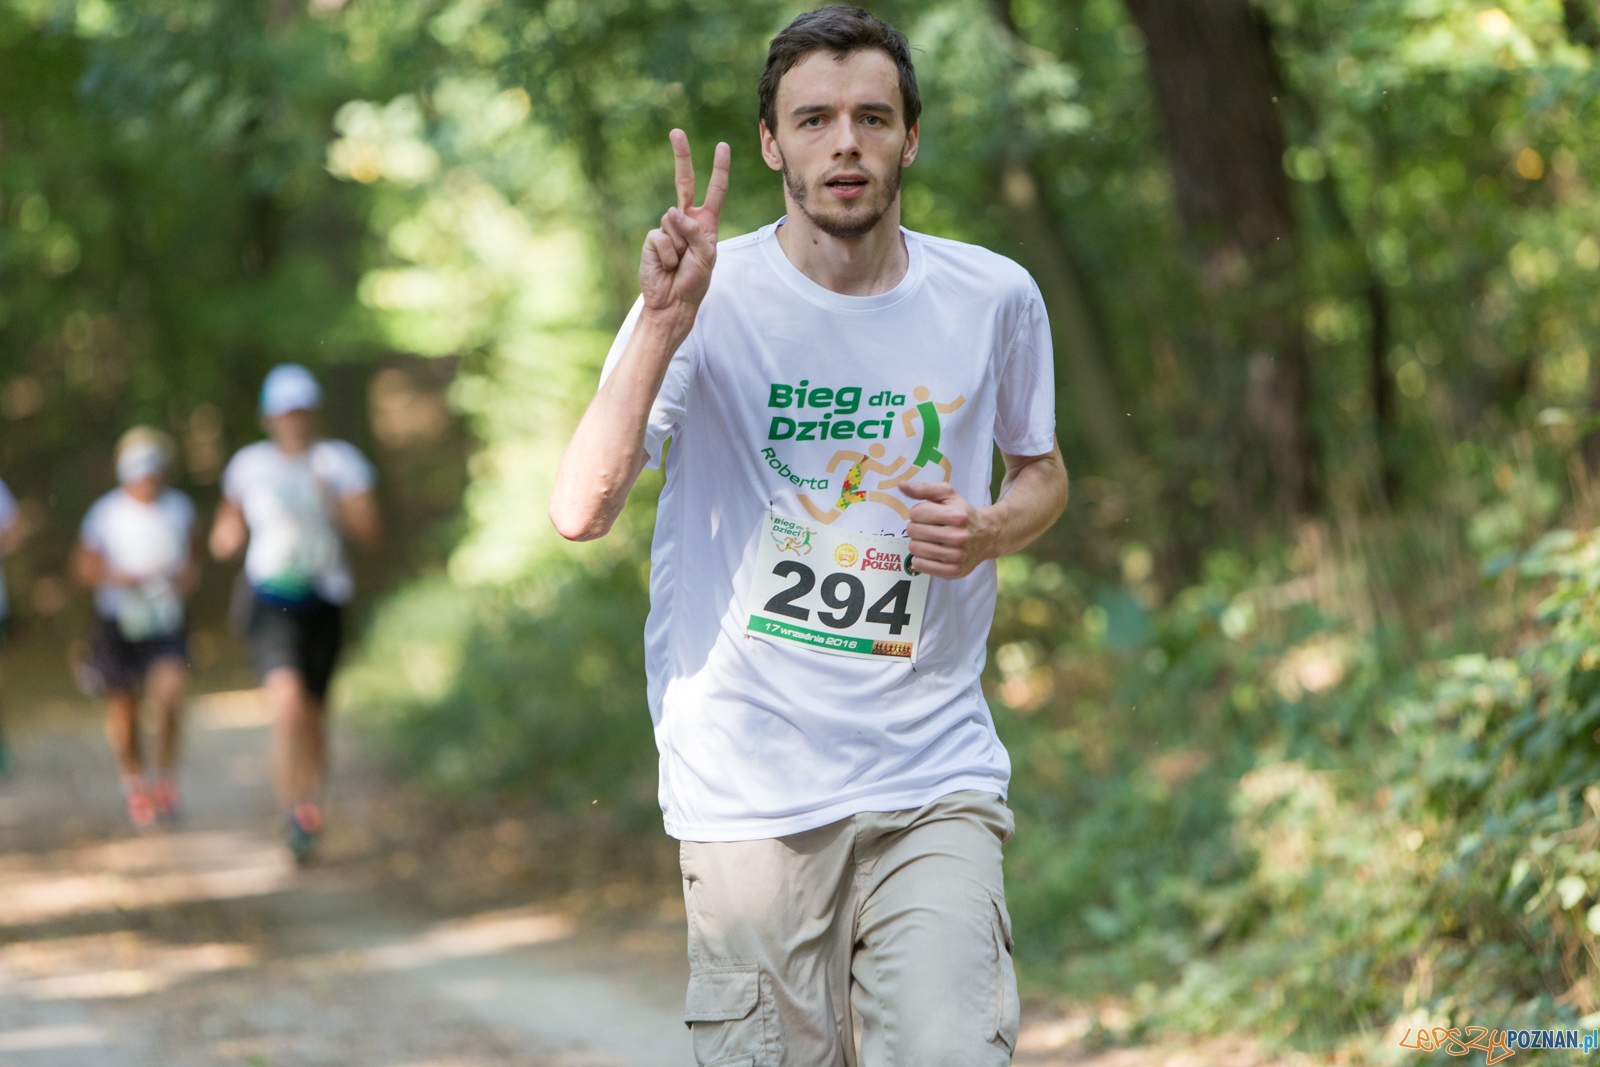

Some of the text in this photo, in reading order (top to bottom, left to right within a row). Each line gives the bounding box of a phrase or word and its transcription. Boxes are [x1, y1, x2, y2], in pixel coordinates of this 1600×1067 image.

[767, 379, 906, 415] Bieg dla
[767, 411, 895, 442] Dzieci
[761, 446, 829, 490] Roberta
[860, 558, 902, 572] POLSKA
[865, 547, 902, 563] CHATA
[763, 560, 912, 635] 294
[764, 622, 781, 632] 17
[824, 637, 858, 649] 2016
